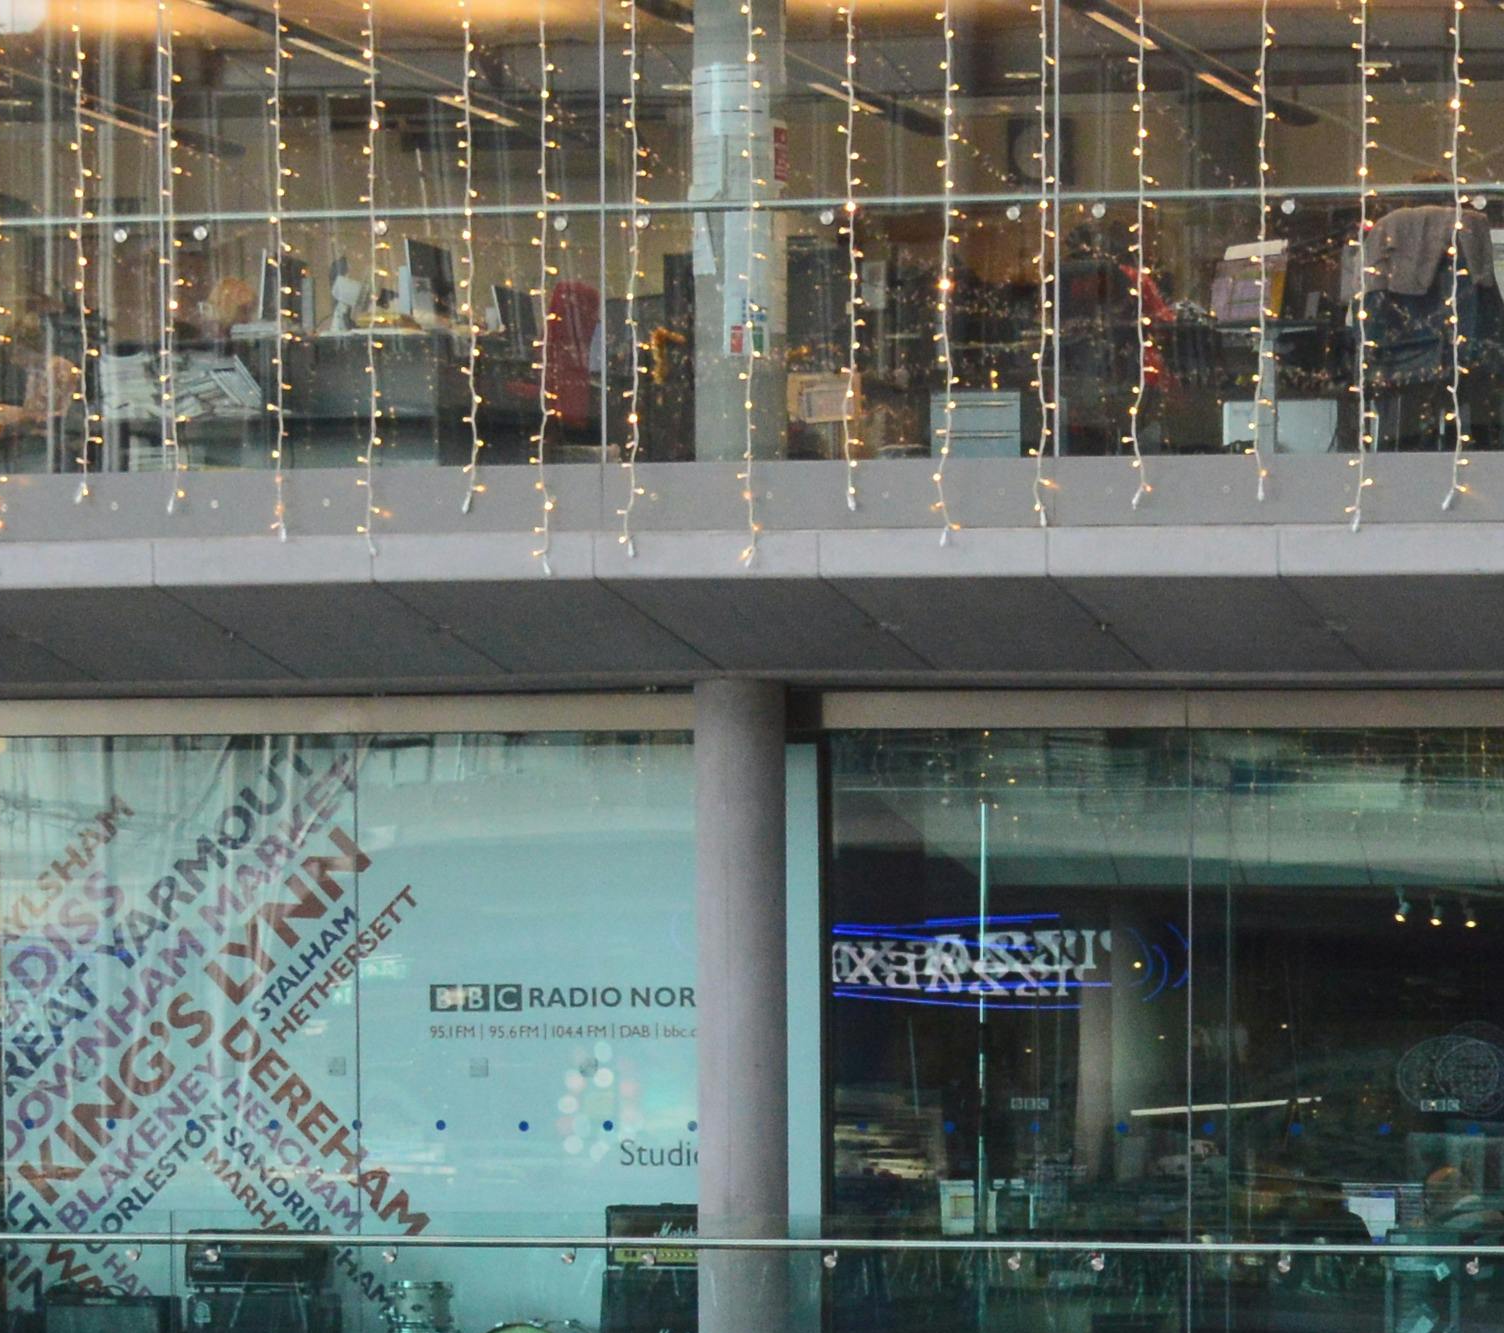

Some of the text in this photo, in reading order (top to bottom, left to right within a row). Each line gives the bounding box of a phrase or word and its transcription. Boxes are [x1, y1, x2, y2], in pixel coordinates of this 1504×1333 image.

[198, 752, 358, 935] MARKET
[8, 871, 124, 996] DISS
[251, 906, 360, 1022] STALHAM
[270, 884, 419, 1045] HETHERSETT
[430, 984, 696, 1012] BBC RADIO NOR
[16, 826, 372, 1206] KING'S LYNN
[620, 1024, 650, 1039] DAB
[55, 1050, 222, 1234] BLAKENEY
[220, 1016, 430, 1236] DEREHAM
[222, 1077, 362, 1232] HEACHAM
